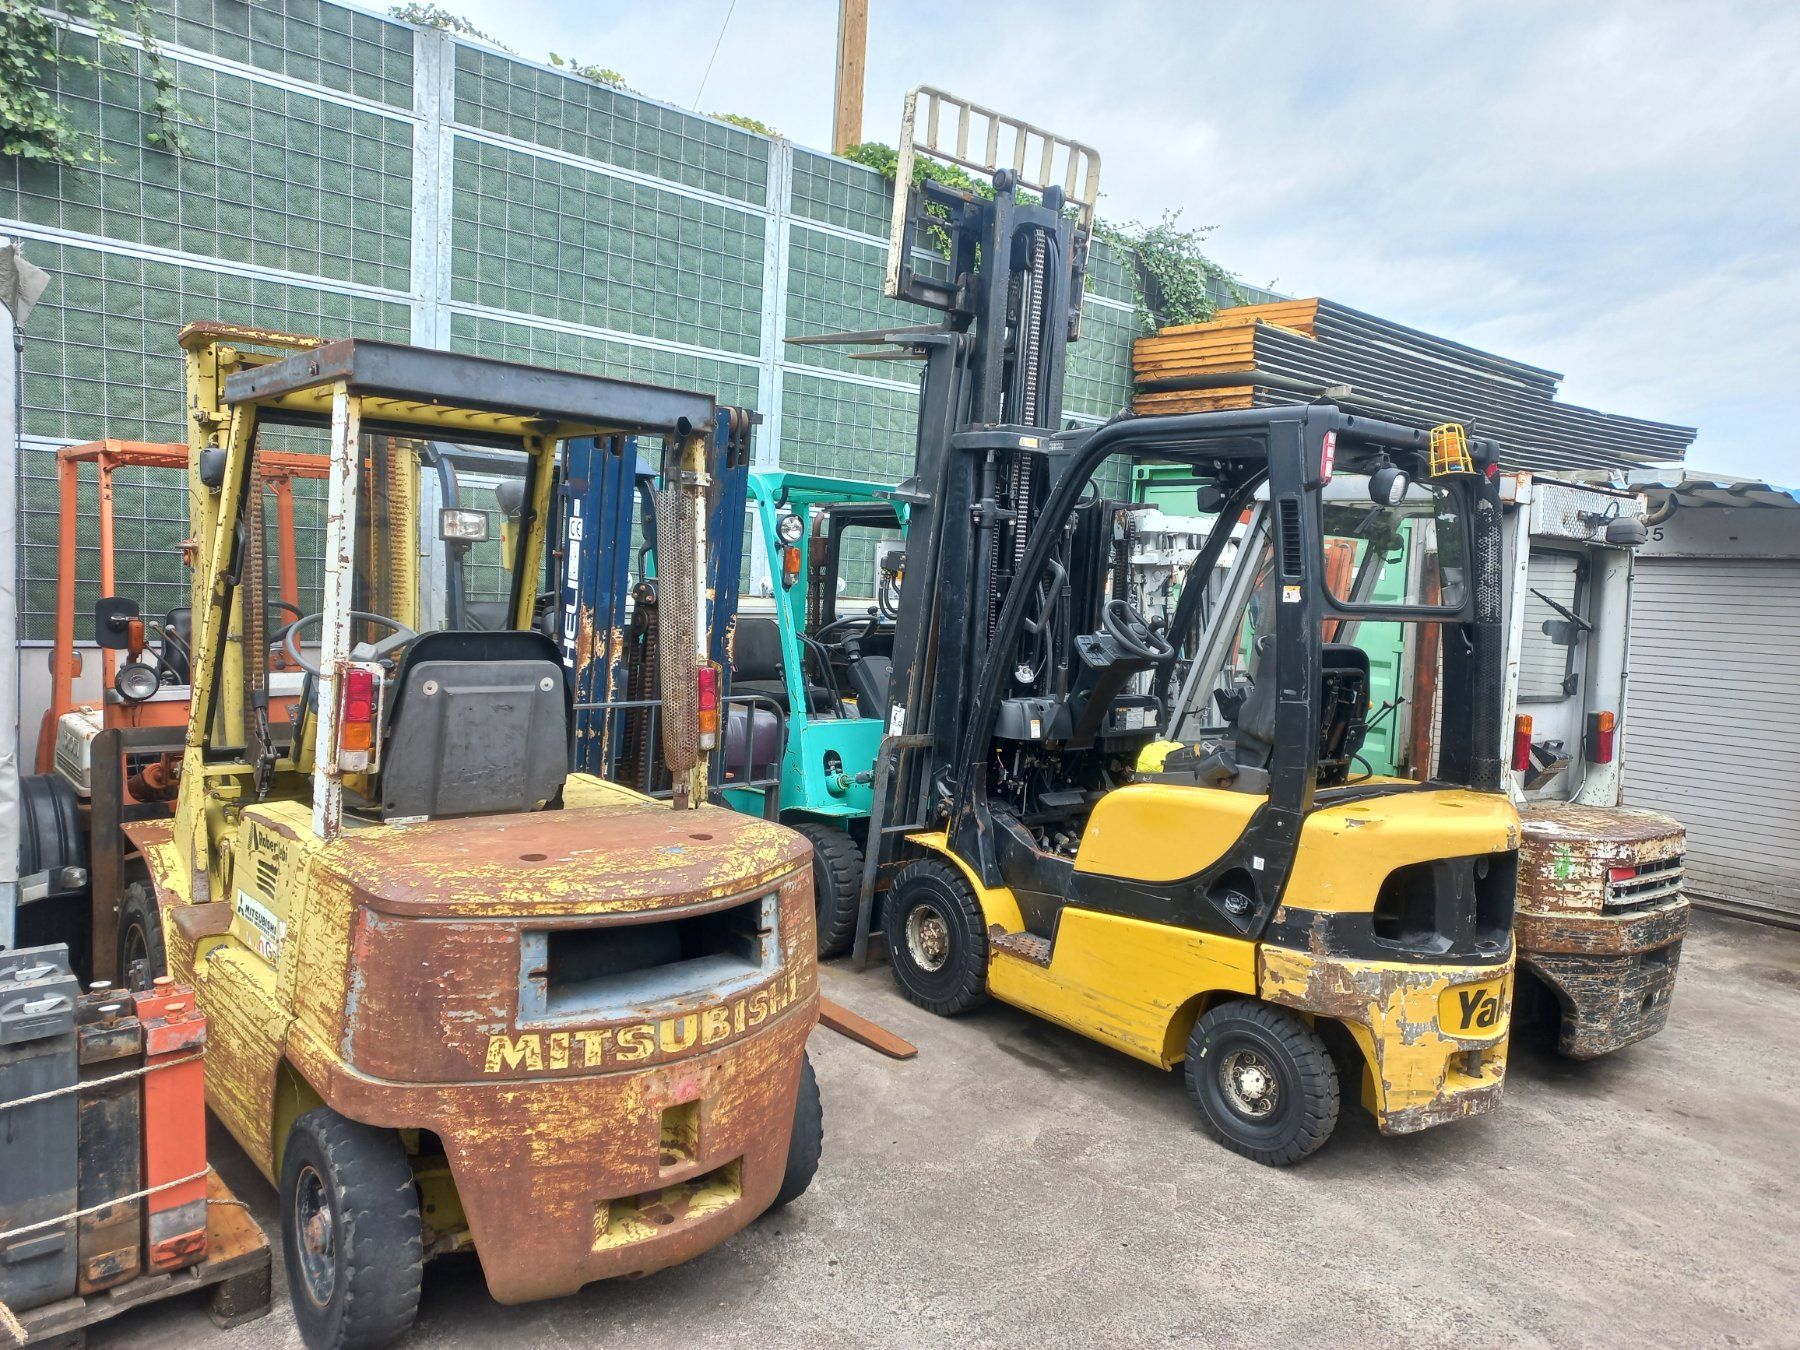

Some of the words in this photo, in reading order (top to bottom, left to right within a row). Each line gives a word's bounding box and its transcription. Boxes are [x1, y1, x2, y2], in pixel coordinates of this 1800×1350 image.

[1645, 527, 1664, 542] 5
[563, 579, 579, 668] HELI
[245, 904, 277, 935] MITSUBISHI
[483, 970, 798, 1073] MITSUBISHI
[1458, 981, 1506, 1030] Yal
